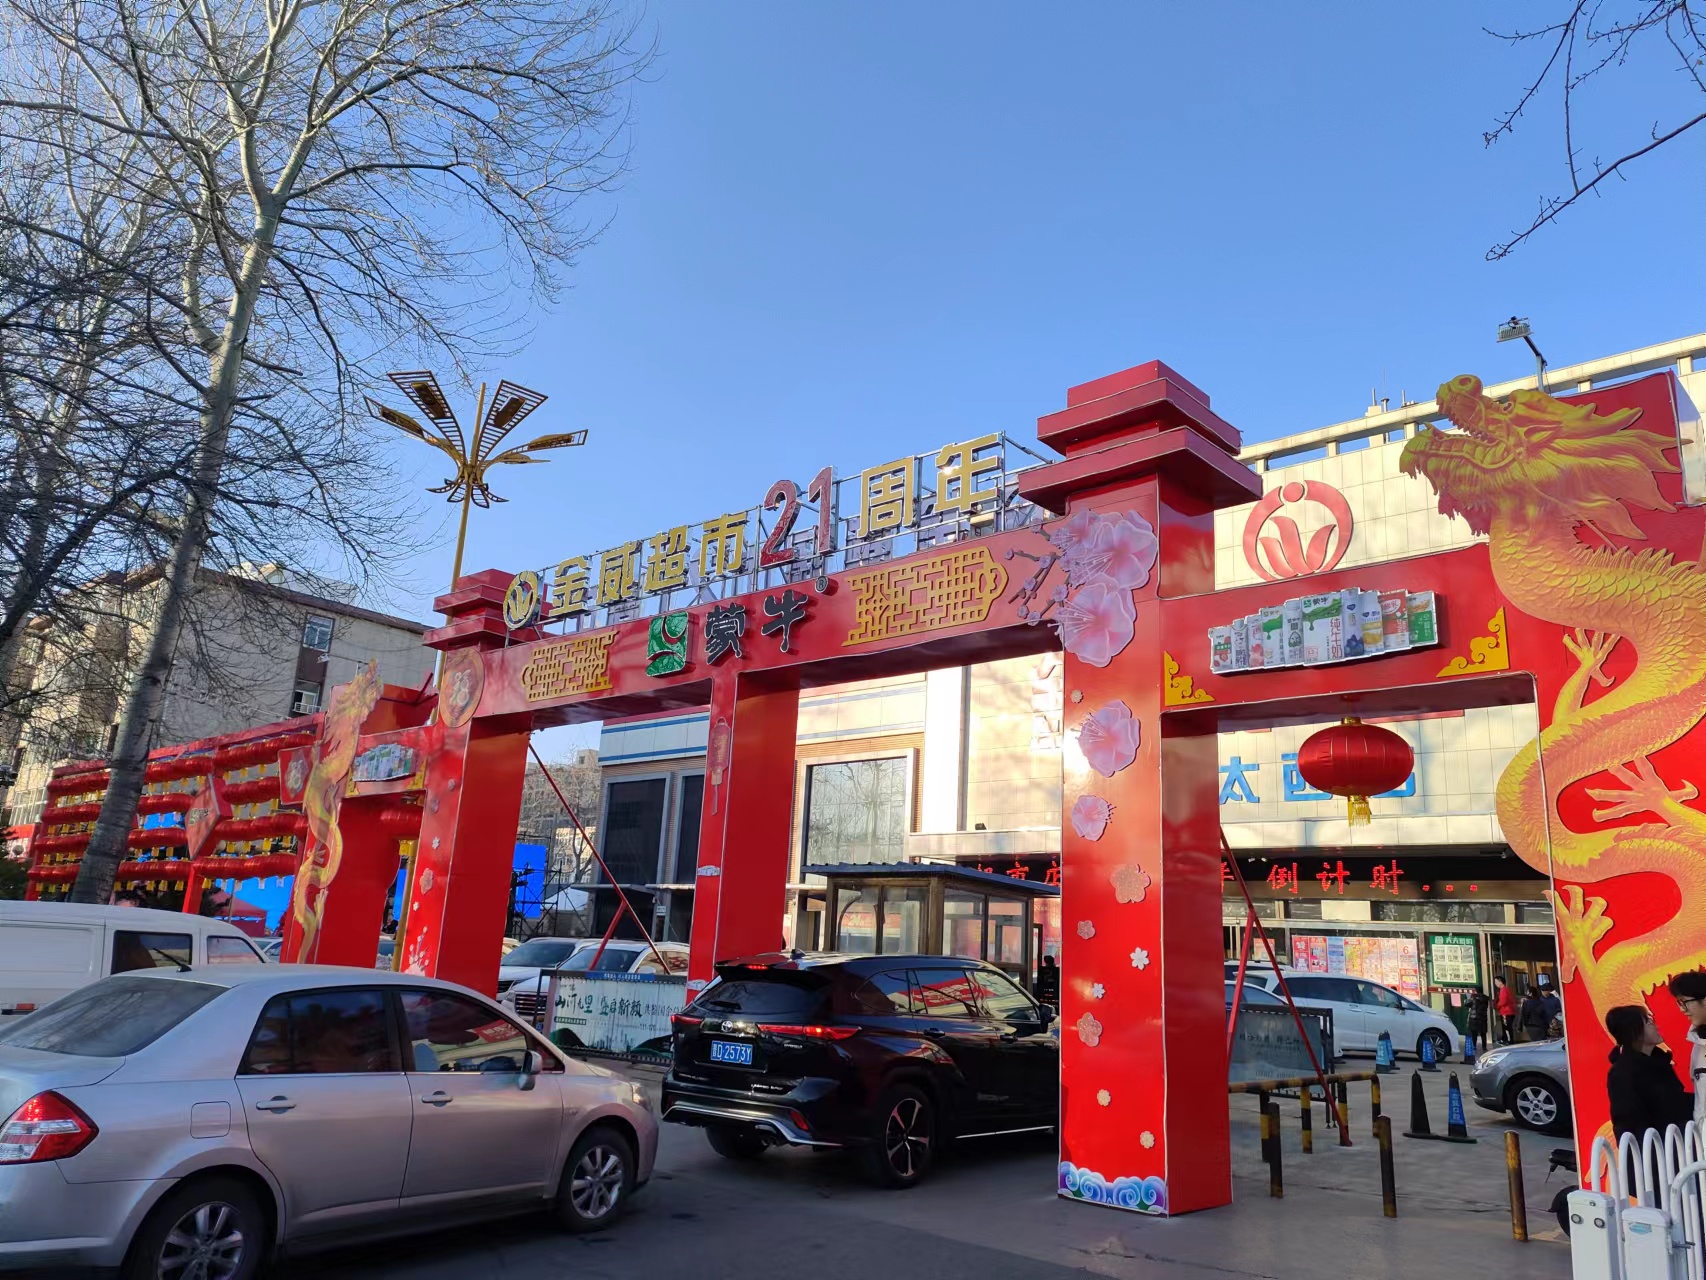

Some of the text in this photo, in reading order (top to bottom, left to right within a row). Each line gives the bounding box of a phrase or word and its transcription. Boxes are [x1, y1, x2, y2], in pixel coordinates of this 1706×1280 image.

[551, 431, 1003, 617] 金威超市21周年
[704, 588, 809, 665] 蒙牛
